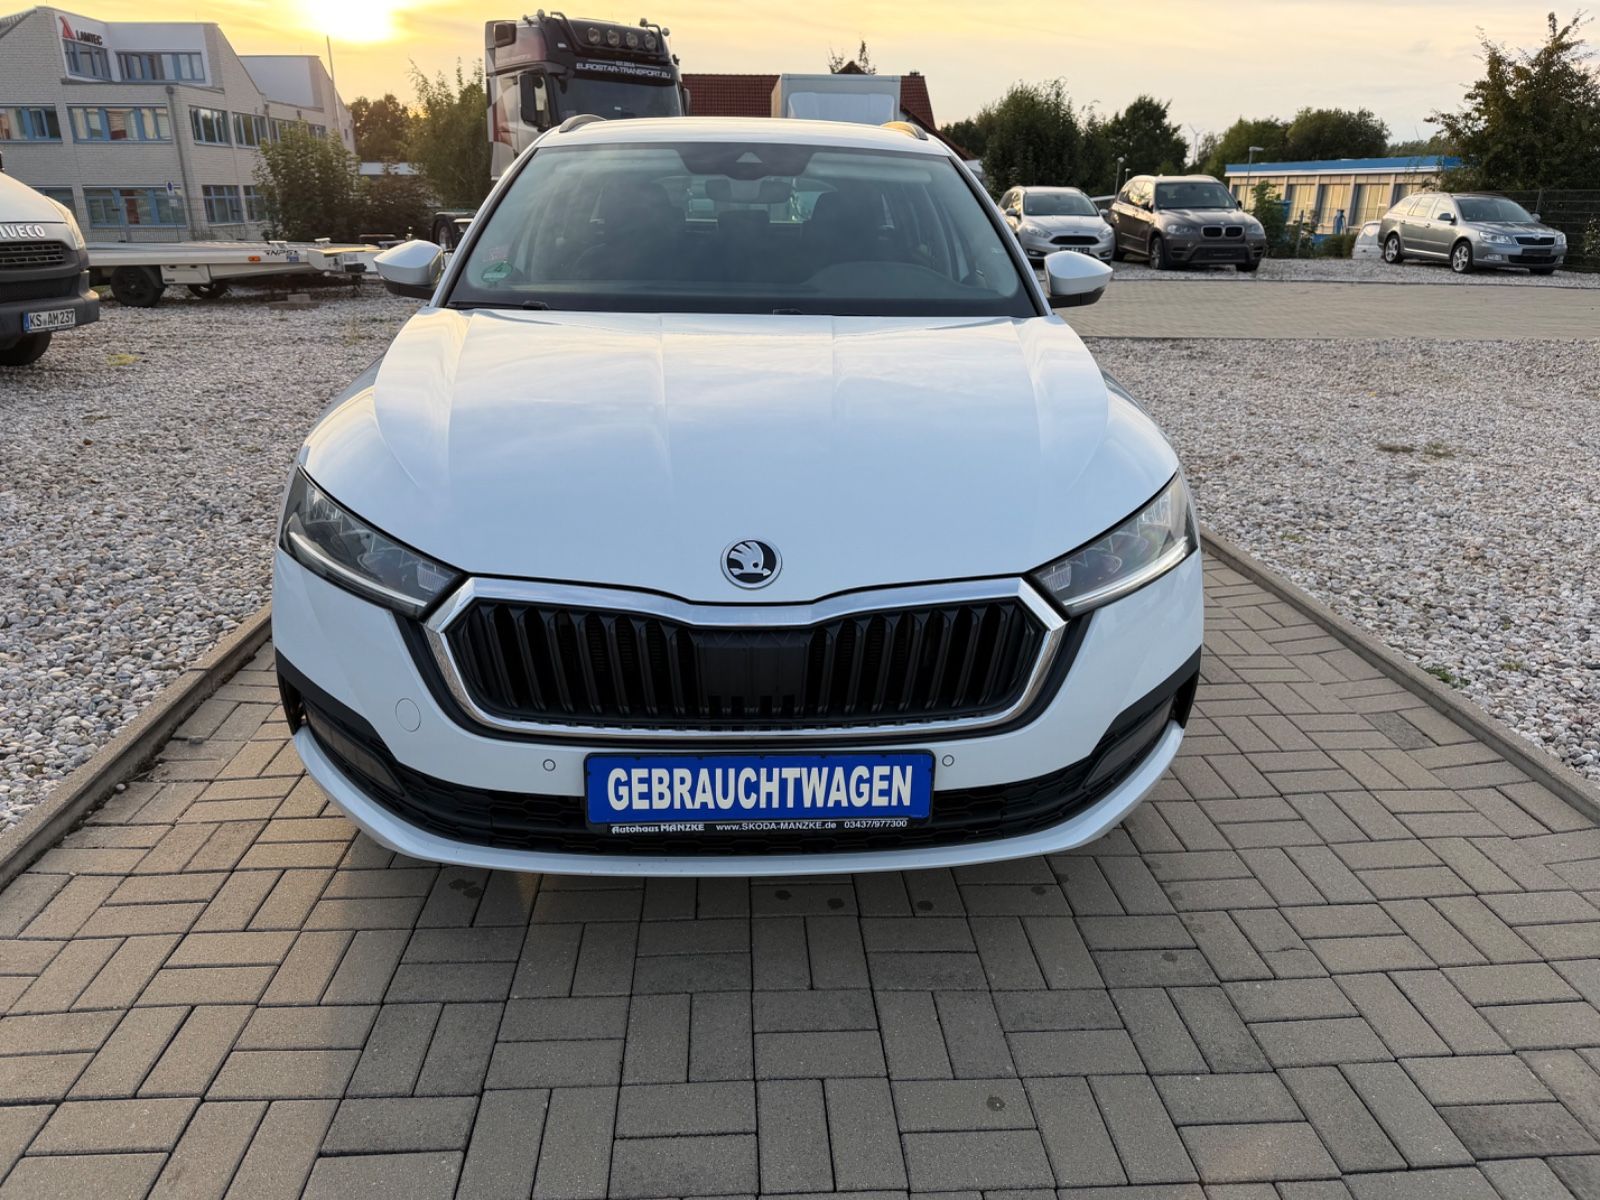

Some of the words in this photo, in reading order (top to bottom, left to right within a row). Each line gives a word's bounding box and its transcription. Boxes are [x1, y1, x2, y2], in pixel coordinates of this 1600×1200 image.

[75, 29, 103, 46] LAMTEC
[0, 224, 46, 238] IVECO
[30, 313, 42, 327] KS
[48, 311, 59, 326] AM
[60, 310, 74, 324] 237
[607, 765, 913, 811] GEBRAUCHTWAGEN
[611, 824, 659, 835] Autohaus
[660, 823, 705, 832] MANZKE
[715, 820, 837, 831] www.SKODA-MANZKE.de
[844, 819, 908, 829] 03437/977300
